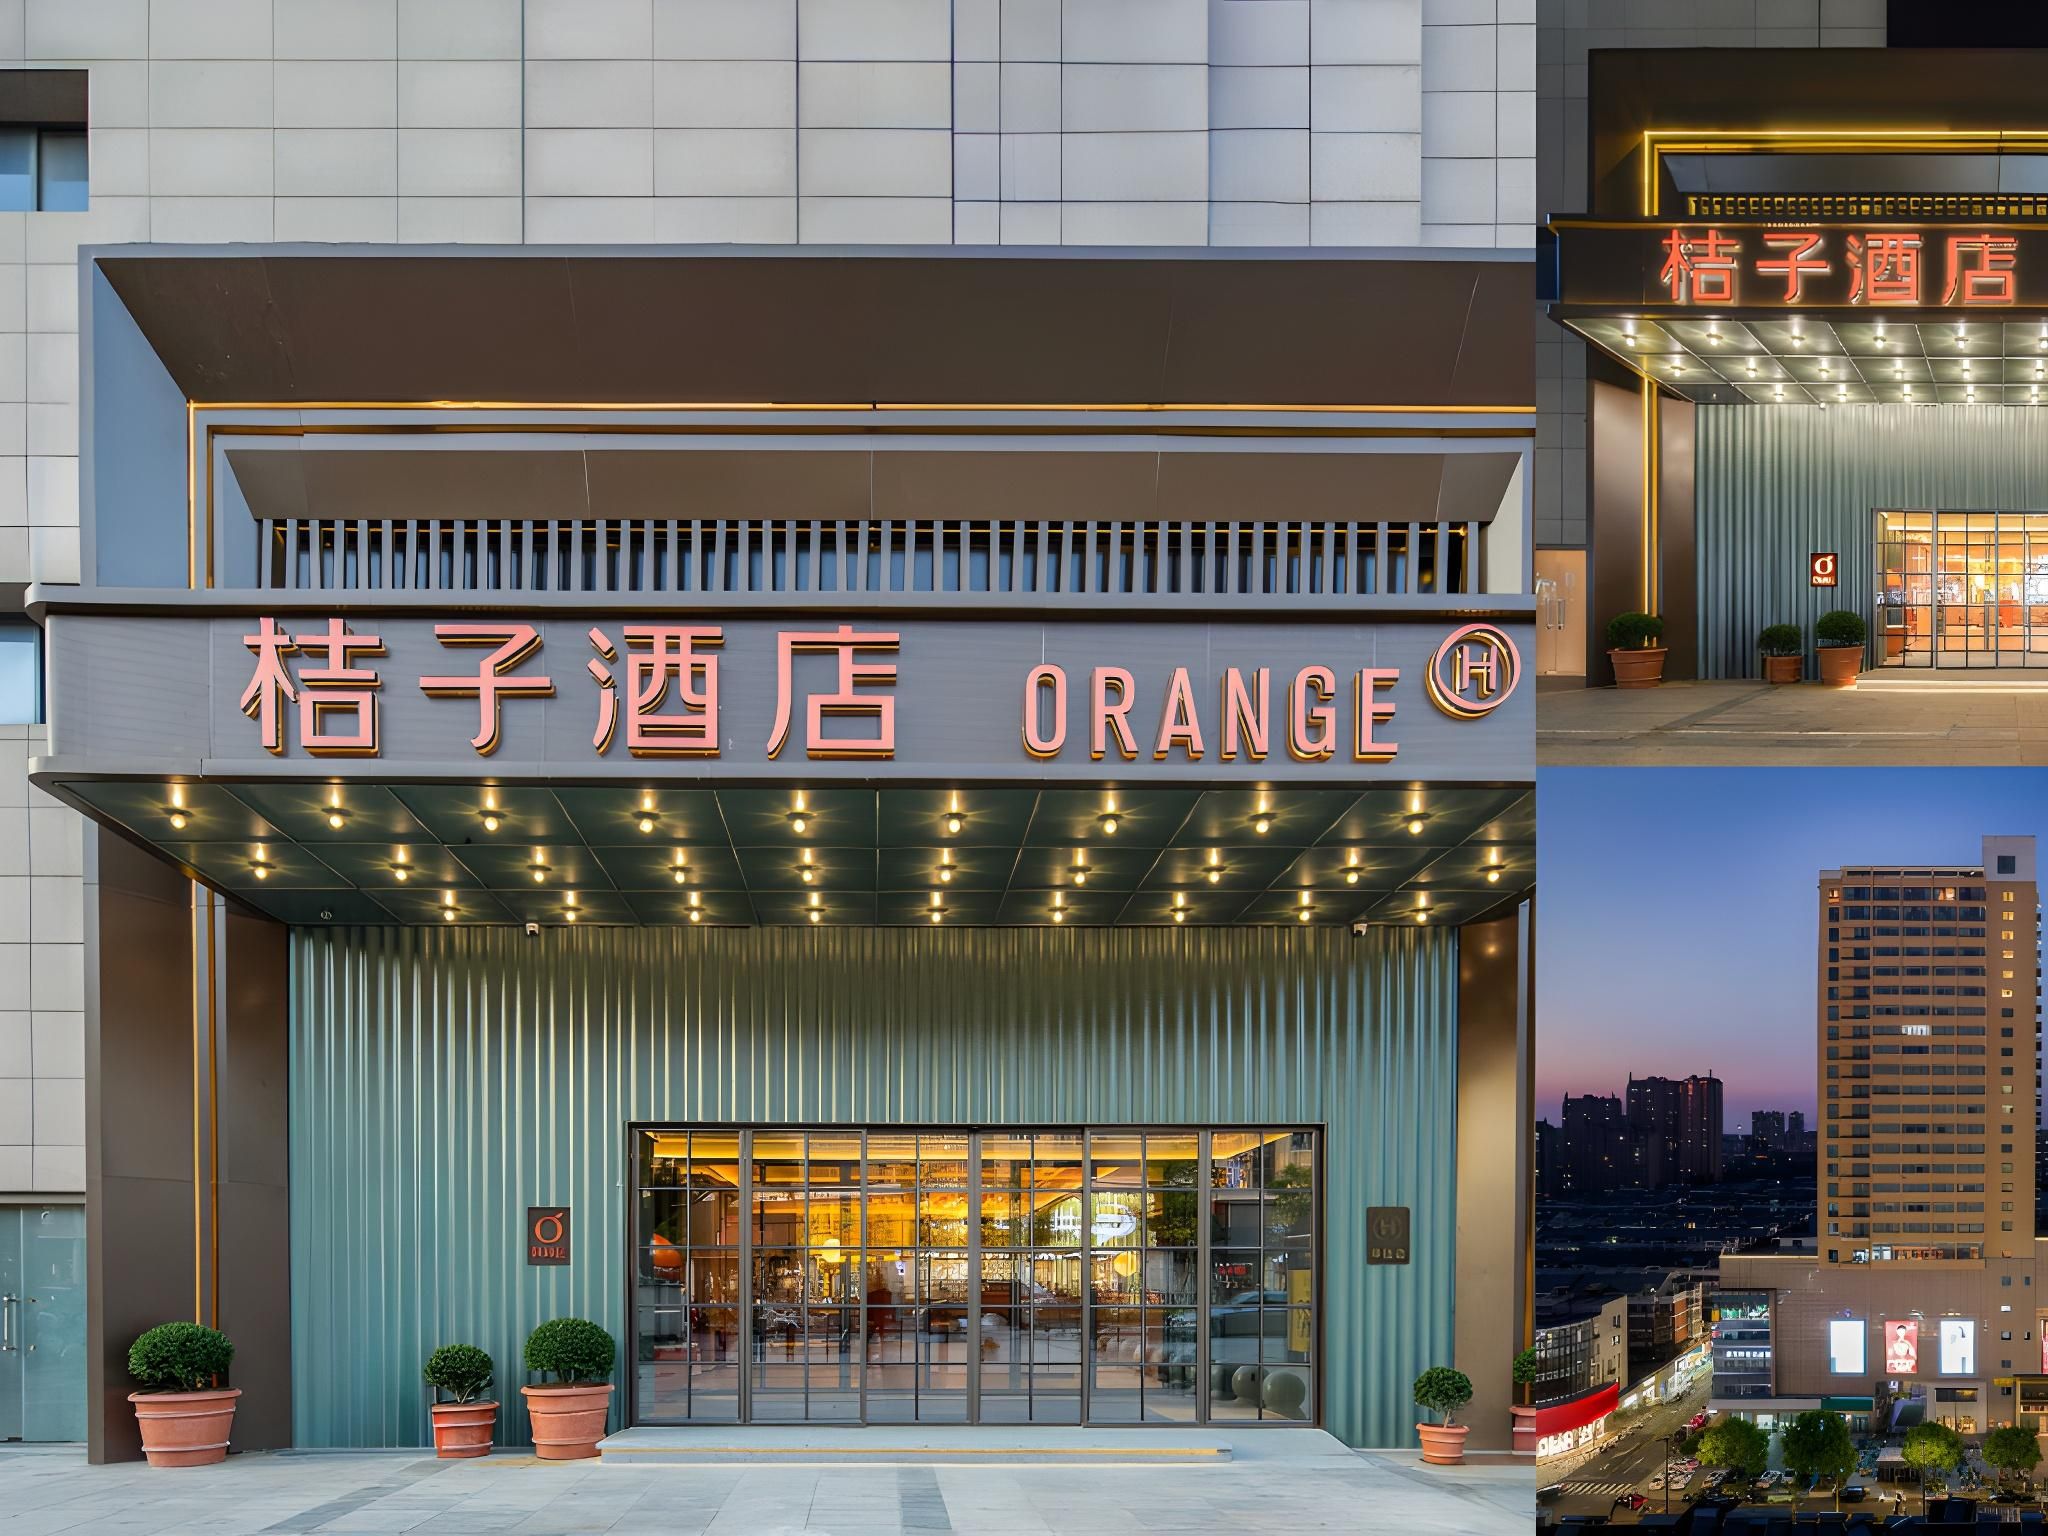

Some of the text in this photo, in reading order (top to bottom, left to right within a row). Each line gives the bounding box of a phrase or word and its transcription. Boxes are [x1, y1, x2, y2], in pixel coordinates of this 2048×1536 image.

[1660, 228, 2018, 305] 桔子酒店
[240, 617, 901, 758] 桔子酒店
[1022, 664, 1400, 760] ORANGE
